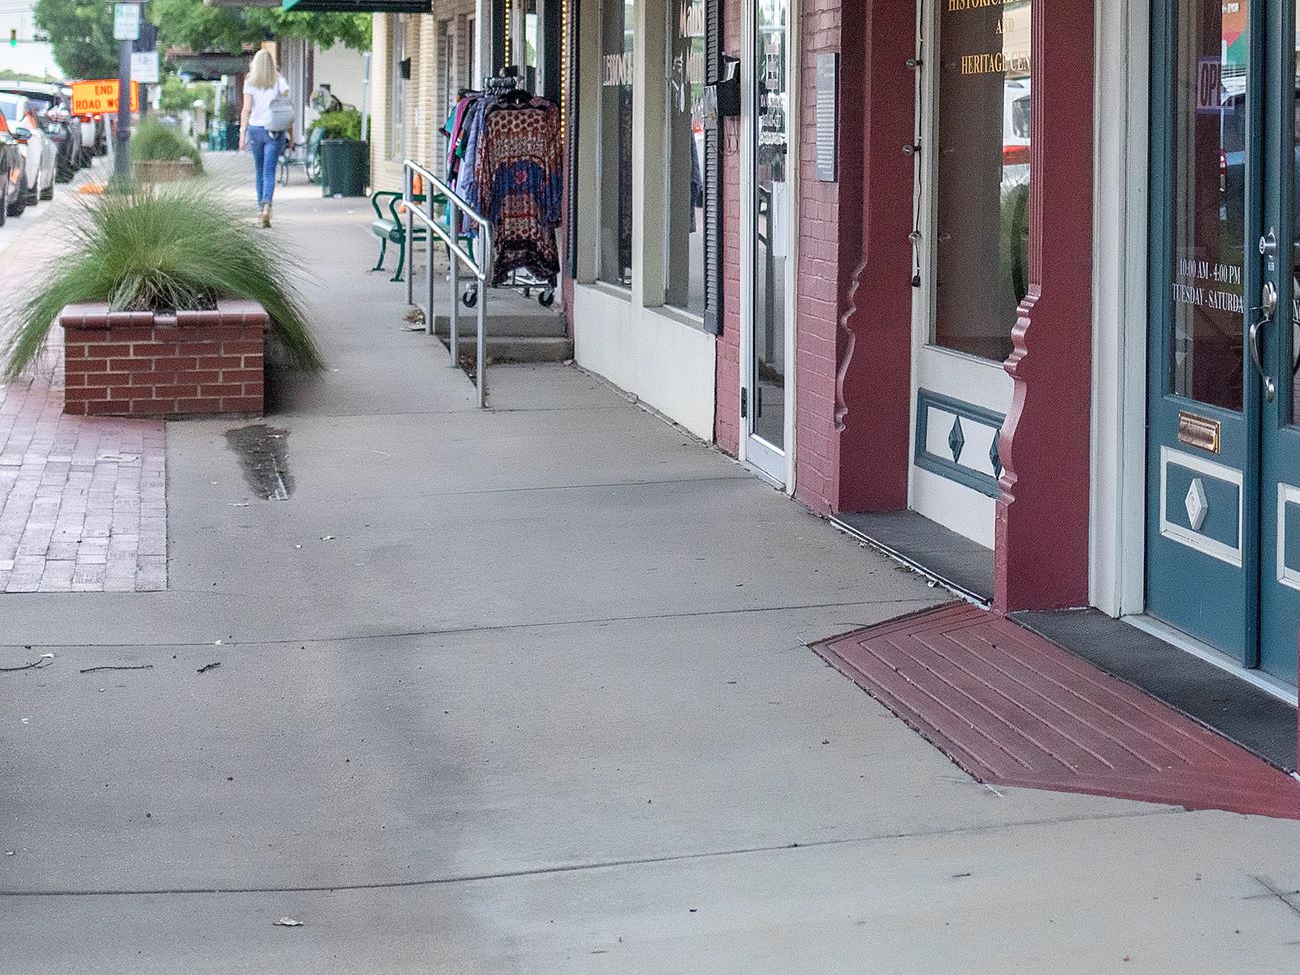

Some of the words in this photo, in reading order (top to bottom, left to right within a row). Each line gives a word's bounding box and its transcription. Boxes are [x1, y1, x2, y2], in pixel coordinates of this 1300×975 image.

[995, 18, 1015, 35] AND
[961, 53, 1008, 75] HERITAGE
[1010, 51, 1031, 72] CEN
[95, 85, 113, 96] END
[76, 99, 101, 110] ROAD
[1180, 258, 1197, 278] 10:00
[1196, 261, 1209, 280] AM
[1213, 263, 1228, 282] 4:00
[1228, 265, 1241, 285] PM
[1172, 283, 1205, 306] TUESDAY
[1208, 290, 1244, 313] SATURDA
